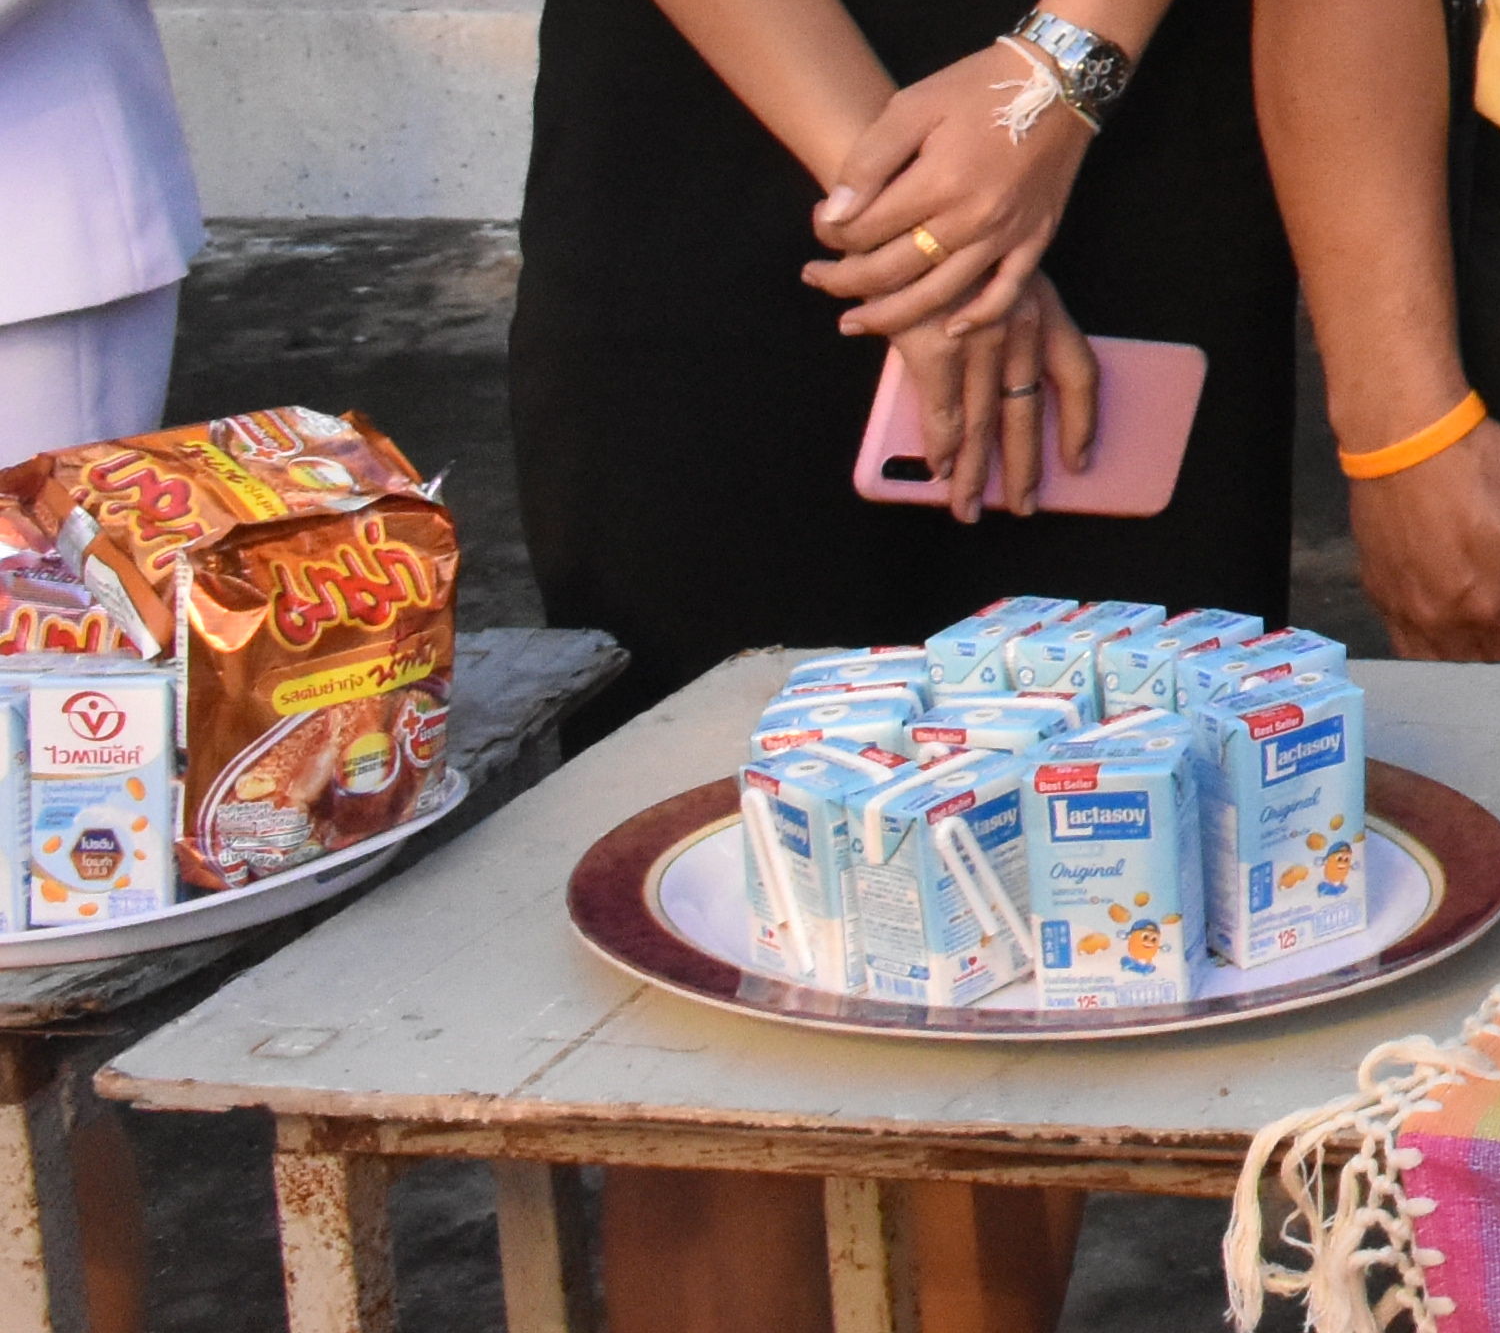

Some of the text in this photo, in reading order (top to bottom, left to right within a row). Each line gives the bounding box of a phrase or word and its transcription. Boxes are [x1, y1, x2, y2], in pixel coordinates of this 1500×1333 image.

[275, 521, 428, 645] มาม่า
[1254, 716, 1301, 737] Best Seller
[1265, 733, 1341, 783] Lactasoy
[1038, 779, 1093, 791] Best Seller
[1053, 800, 1146, 837] Lactasoy
[1260, 787, 1321, 824] Original
[1050, 859, 1126, 884] Original
[1277, 929, 1297, 951] 125
